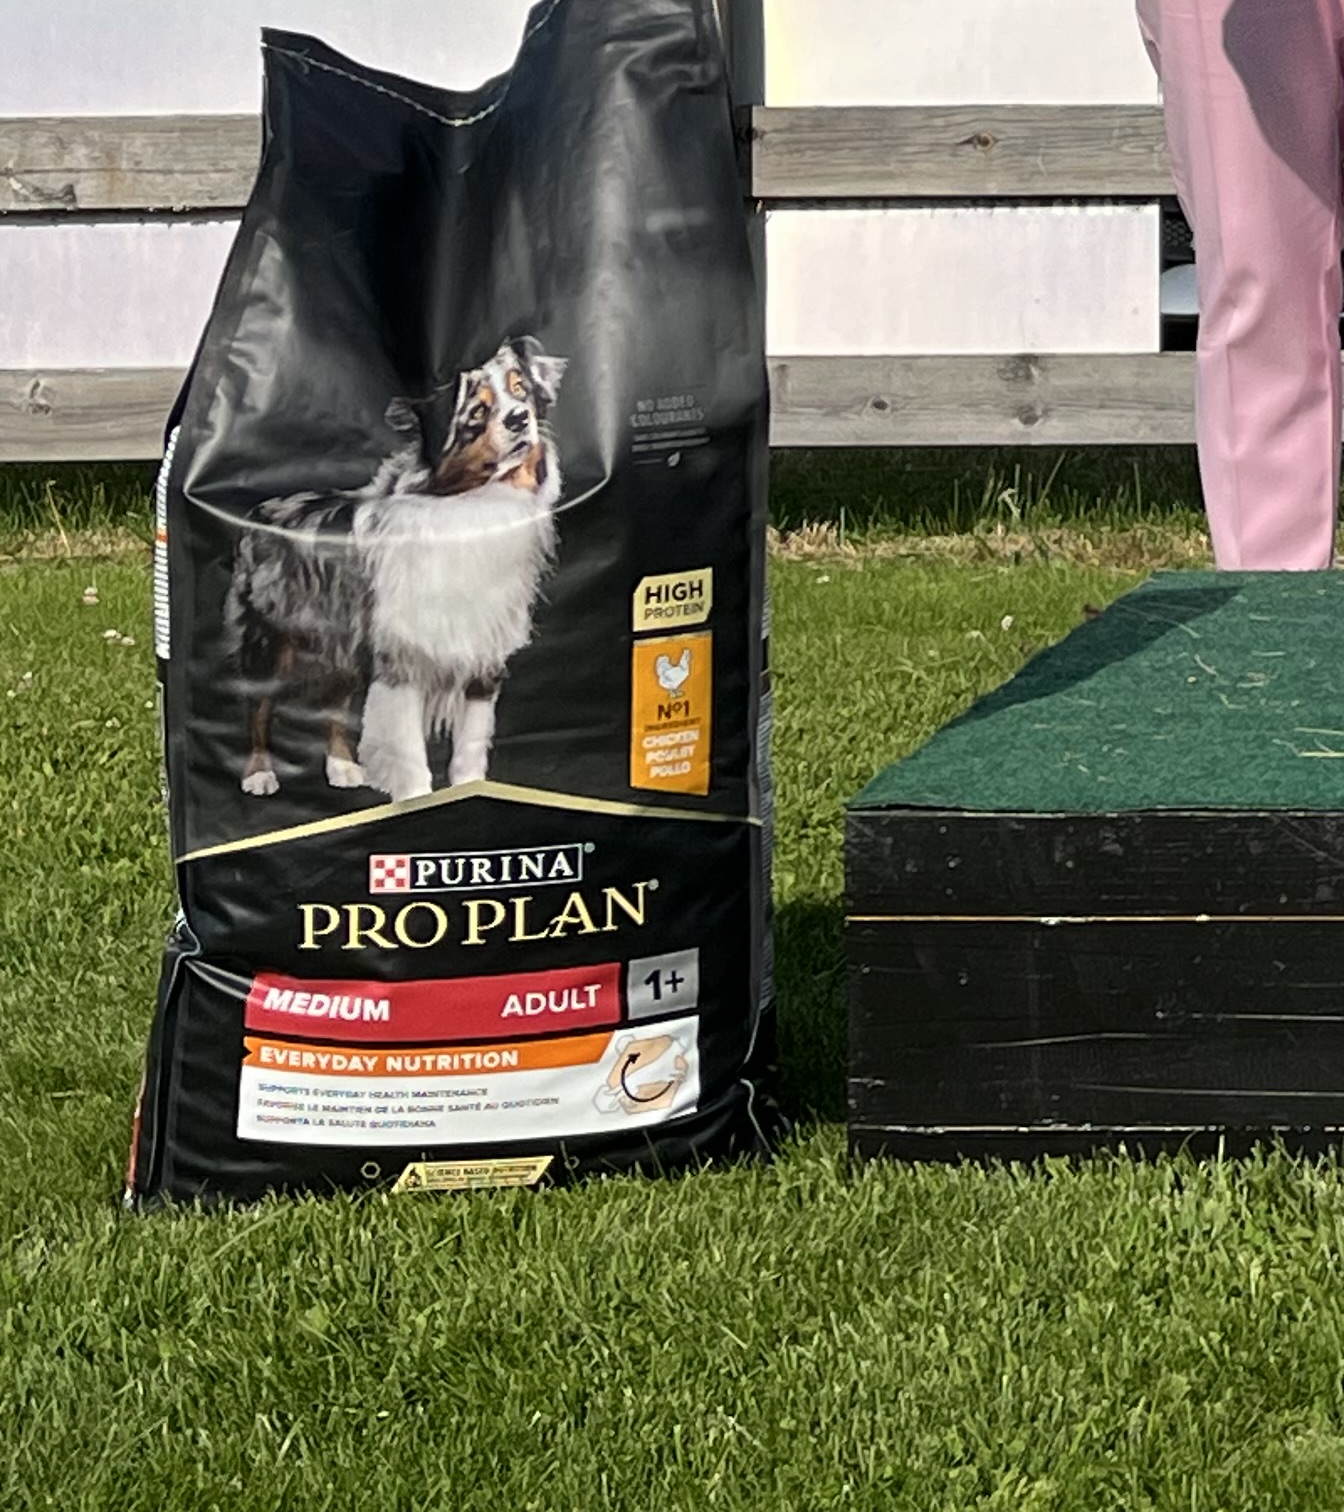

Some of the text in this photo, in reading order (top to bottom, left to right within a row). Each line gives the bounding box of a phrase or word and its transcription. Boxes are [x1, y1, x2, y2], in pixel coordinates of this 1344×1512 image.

[644, 579, 704, 605] HIGH
[644, 601, 705, 621] PROTEIN
[414, 851, 575, 887] PURINA
[297, 881, 649, 950] PRO PLAN
[263, 968, 686, 1022] MEDIUM ADULT 1+
[259, 1046, 519, 1073] EVERYDAY NUTRITION
[307, 1103, 318, 1112] LE
[391, 1105, 404, 1113] LA
